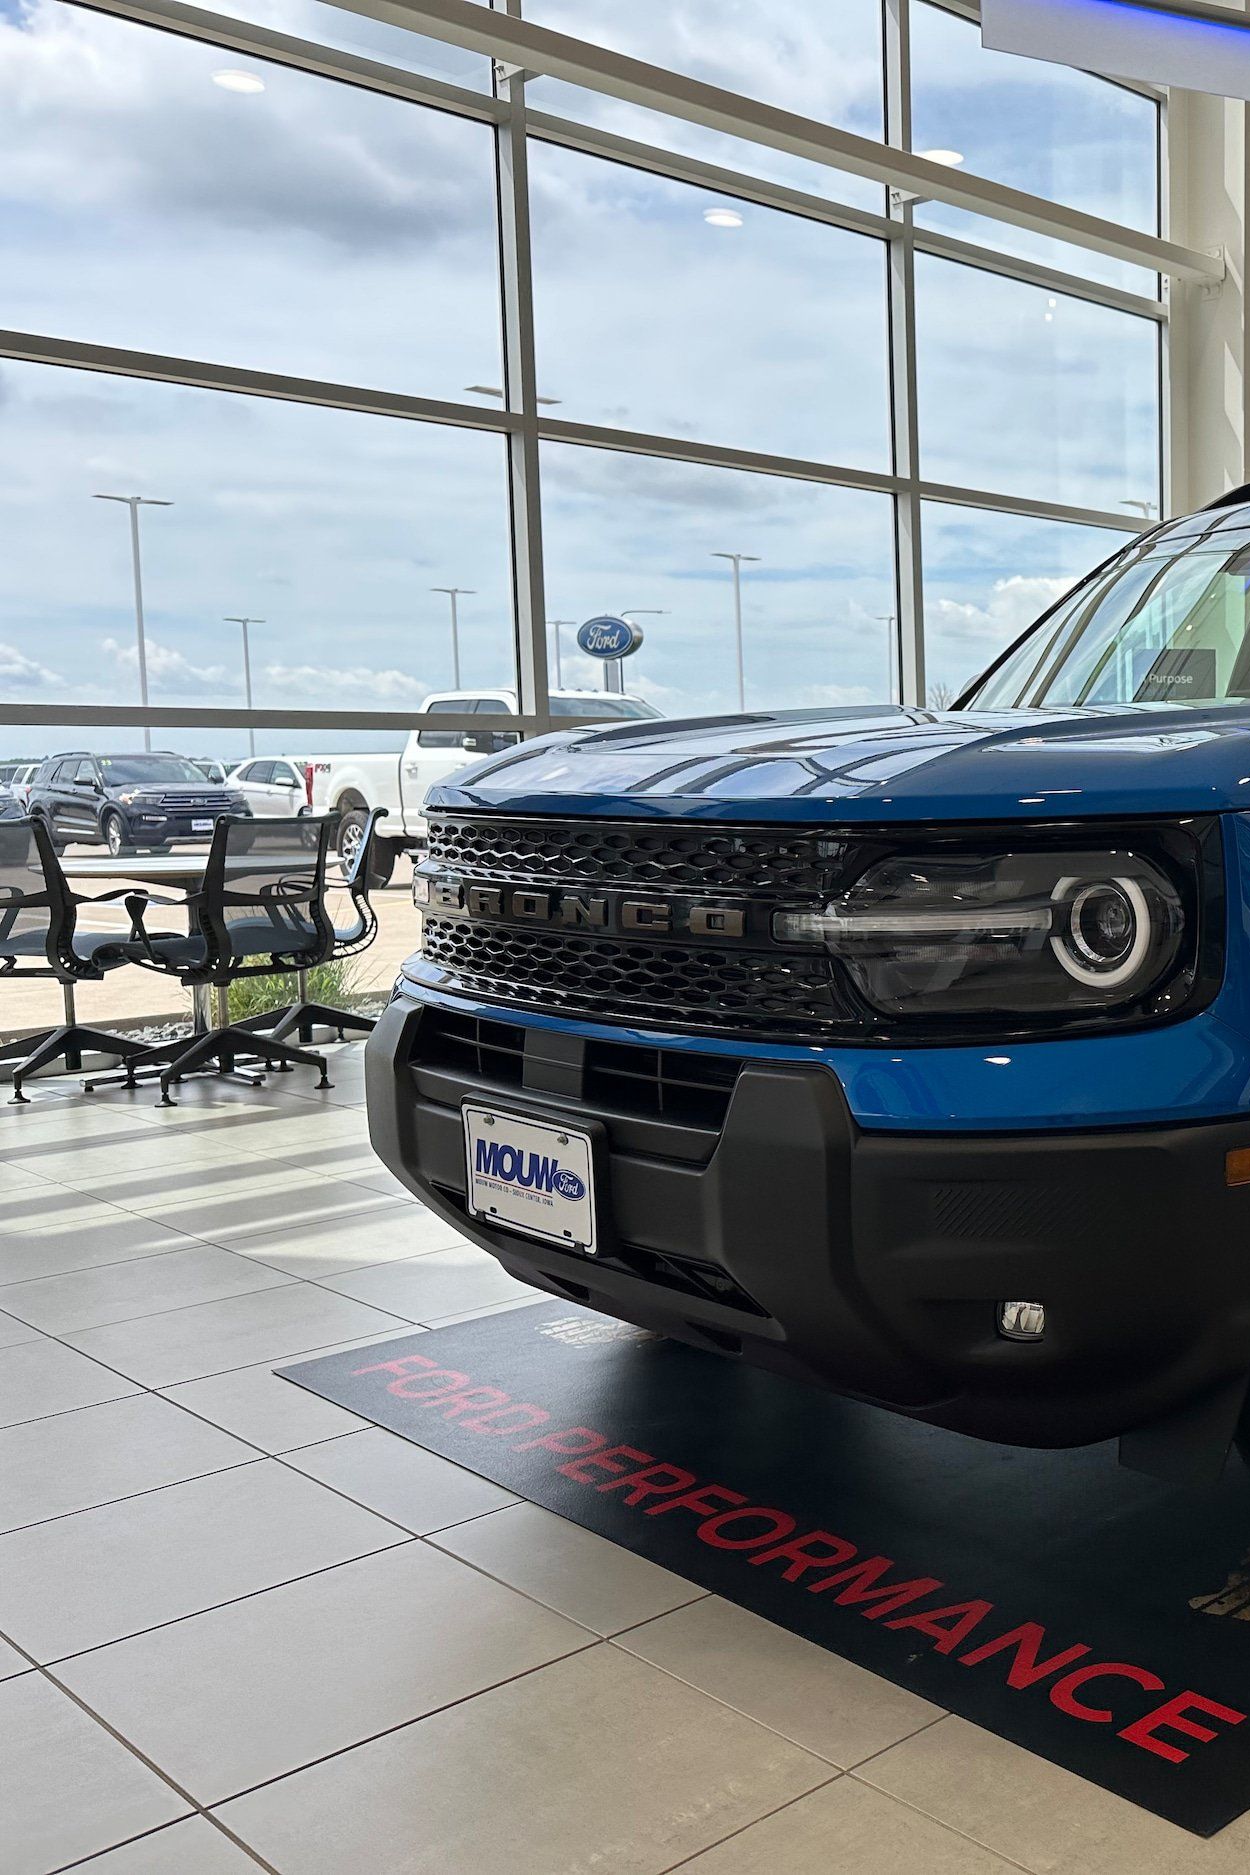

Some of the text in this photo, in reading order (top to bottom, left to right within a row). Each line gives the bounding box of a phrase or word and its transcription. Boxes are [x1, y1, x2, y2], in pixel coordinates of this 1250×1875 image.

[587, 624, 620, 650] Ford
[1149, 674, 1193, 684] Purpose
[434, 880, 747, 938] BRONCO
[475, 1138, 559, 1193] MOUW
[352, 1353, 1249, 1765] FORD PERFORMANCE
